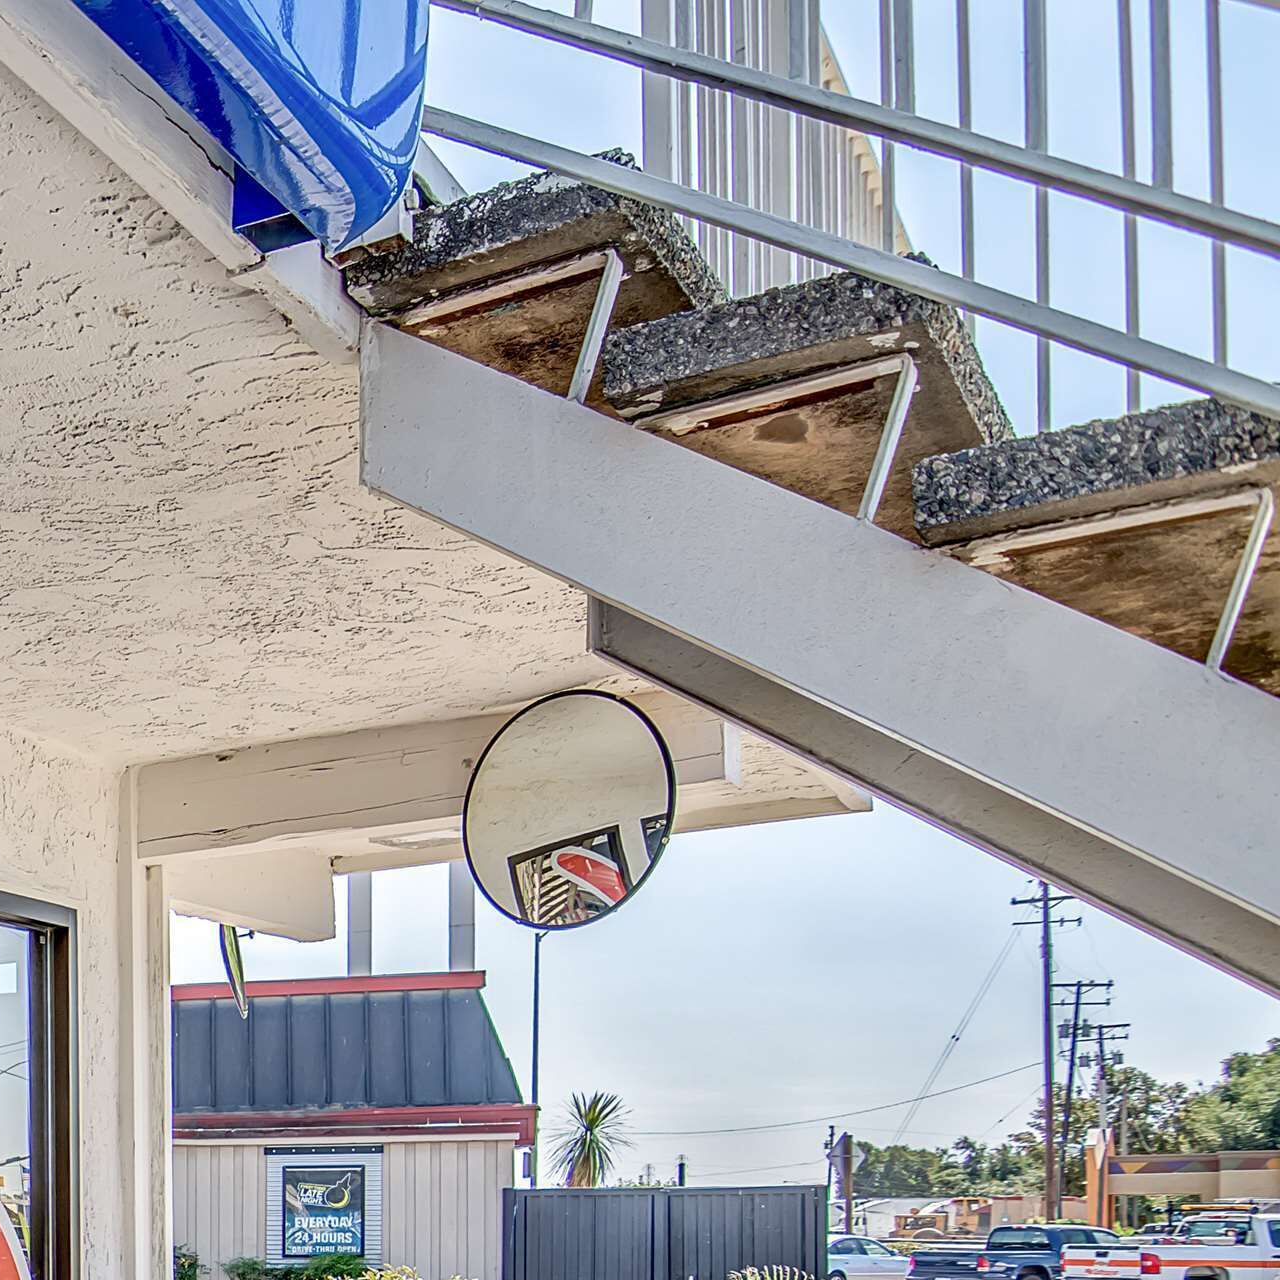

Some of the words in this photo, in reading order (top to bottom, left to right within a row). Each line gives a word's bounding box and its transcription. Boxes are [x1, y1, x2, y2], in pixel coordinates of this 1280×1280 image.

[300, 1188, 324, 1198] LATE
[295, 1216, 353, 1228] EVERYDAY
[295, 1232, 309, 1243] 24
[313, 1232, 353, 1243] HOURS
